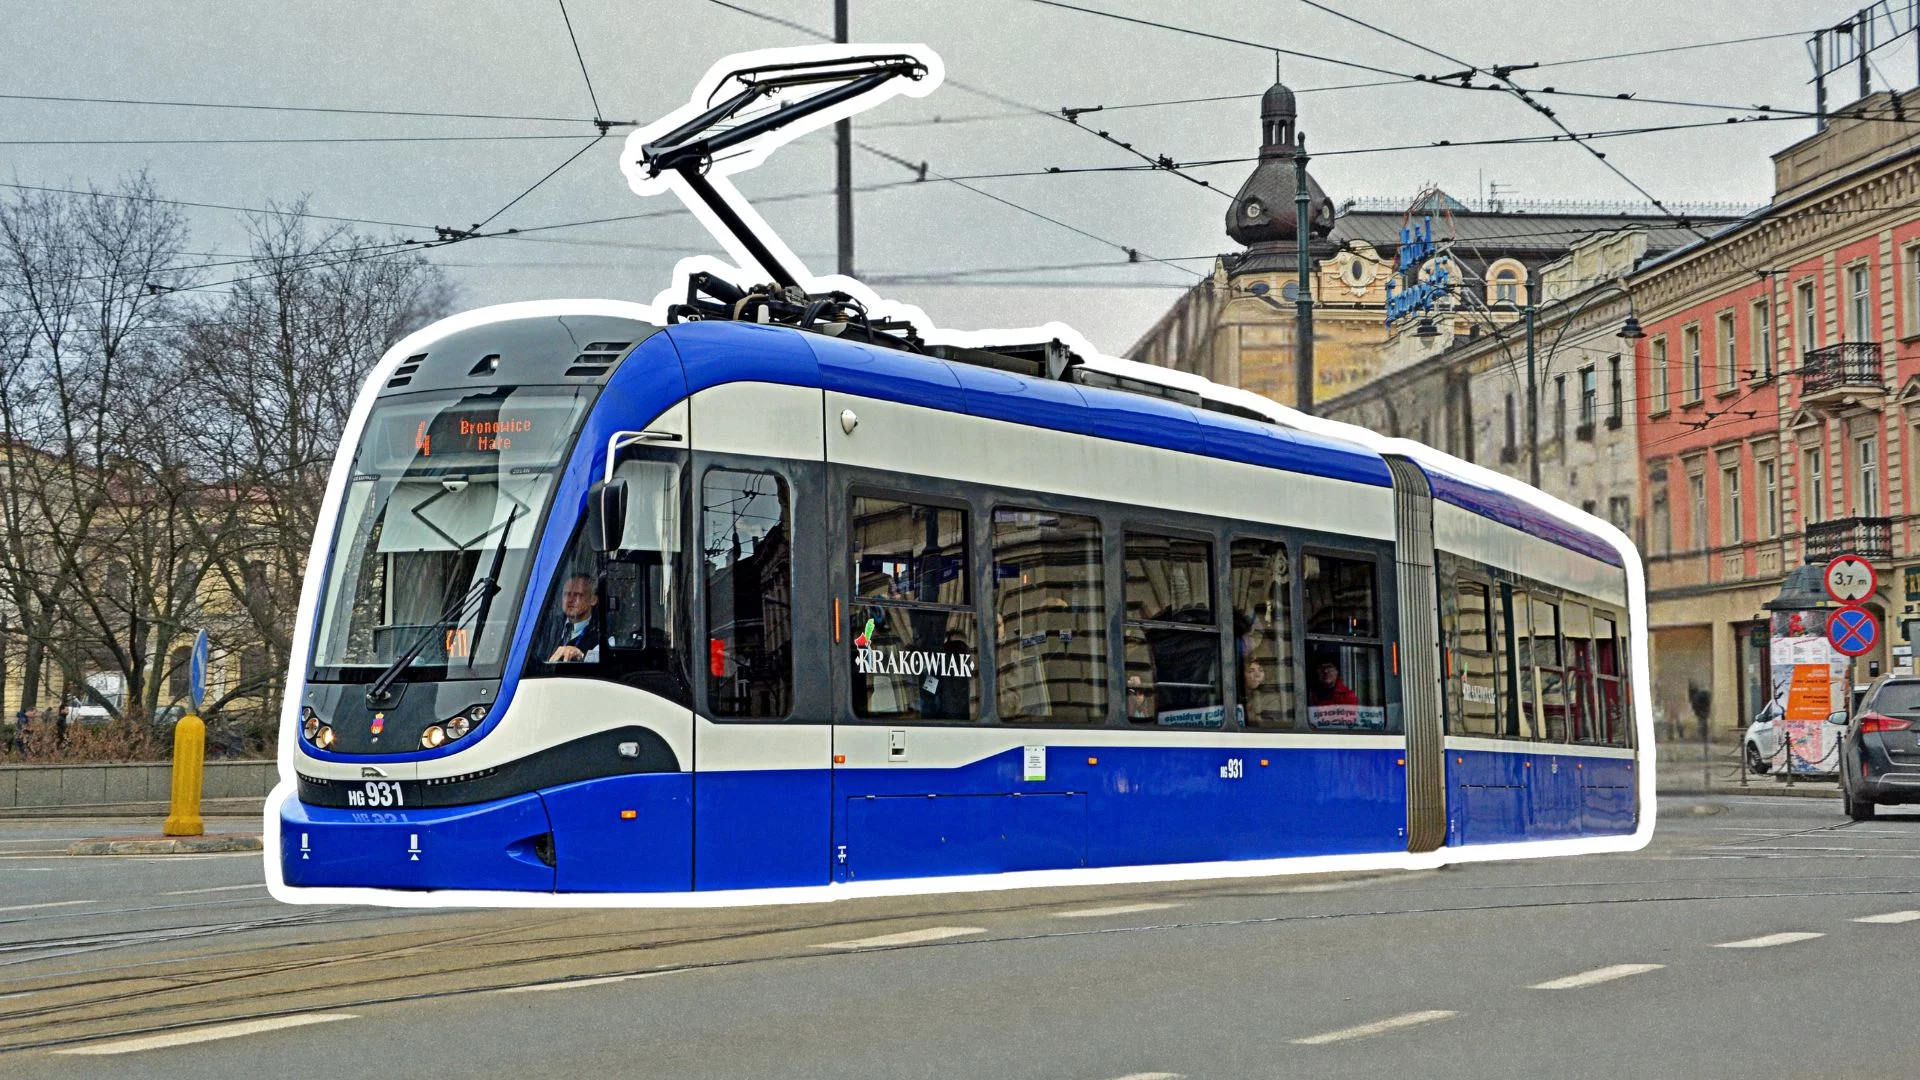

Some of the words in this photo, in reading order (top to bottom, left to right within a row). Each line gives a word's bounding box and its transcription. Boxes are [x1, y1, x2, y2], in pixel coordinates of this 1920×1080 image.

[460, 418, 532, 435] Bronowice
[415, 420, 431, 457] 4
[1834, 572, 1853, 586] 3,7
[857, 648, 972, 677] KRAKOWIAK
[1228, 758, 1243, 779] 931
[348, 790, 365, 806] HG
[365, 781, 404, 807] 931
